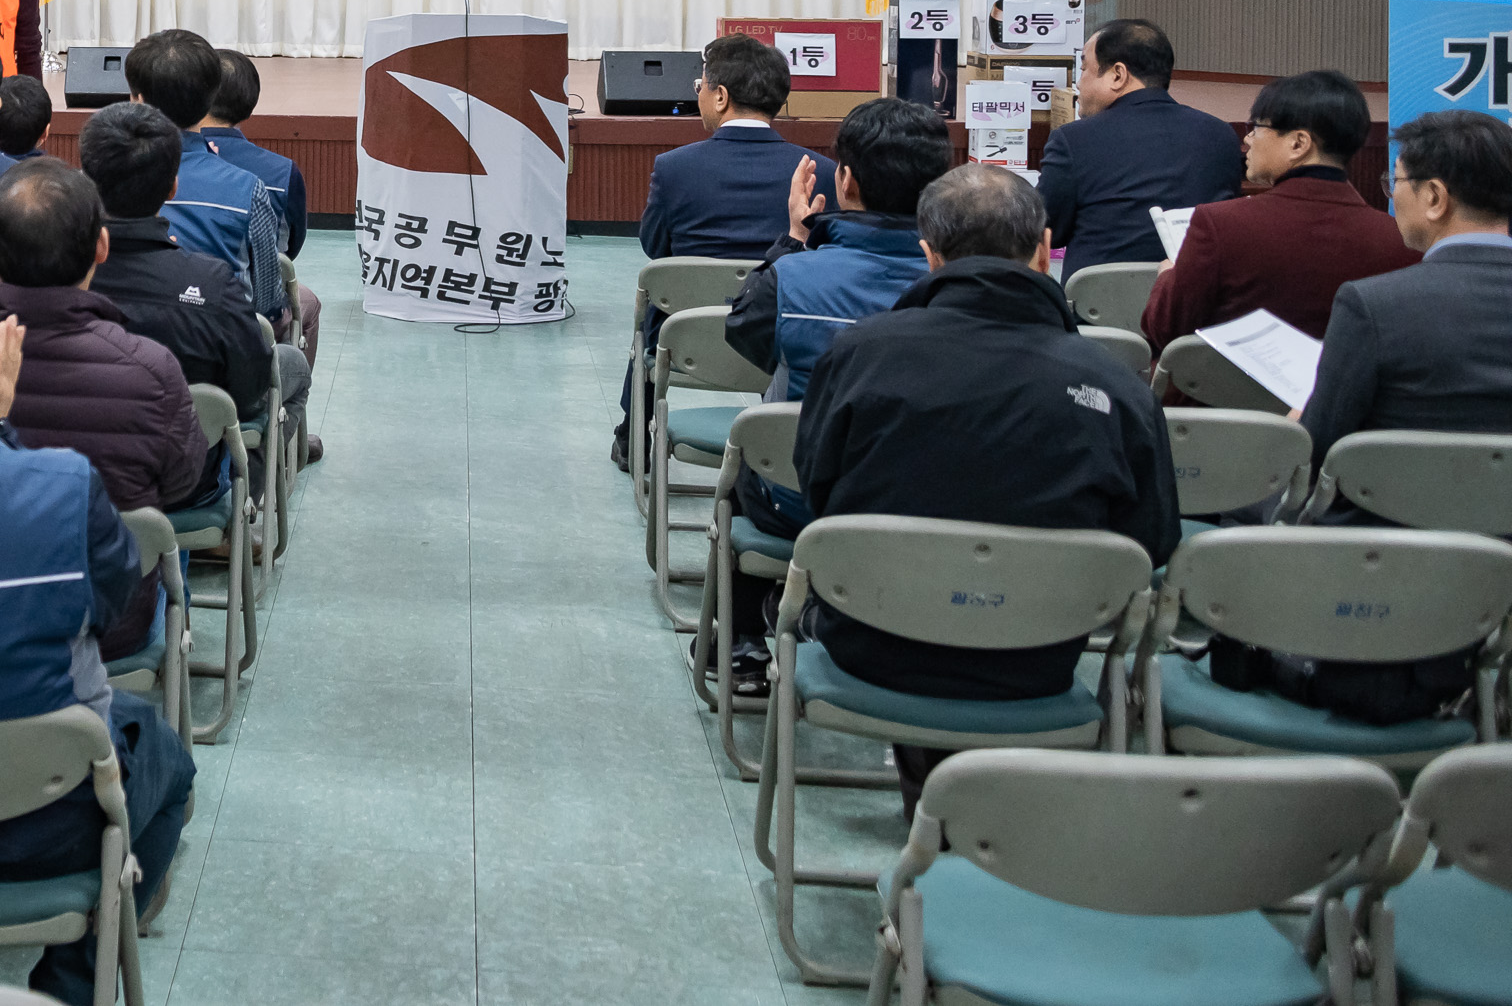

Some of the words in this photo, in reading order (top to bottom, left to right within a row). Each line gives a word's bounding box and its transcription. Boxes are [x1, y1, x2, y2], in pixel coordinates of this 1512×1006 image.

[910, 9, 949, 32] 2등
[1014, 13, 1055, 36] 3등
[729, 25, 743, 35] LG
[746, 25, 766, 35] LED
[768, 25, 783, 35] TV
[846, 26, 867, 41] 80
[790, 45, 825, 69] 1등
[971, 101, 1025, 113] 테팔믹서
[1081, 384, 1098, 396] THE
[1074, 395, 1096, 410] FACE
